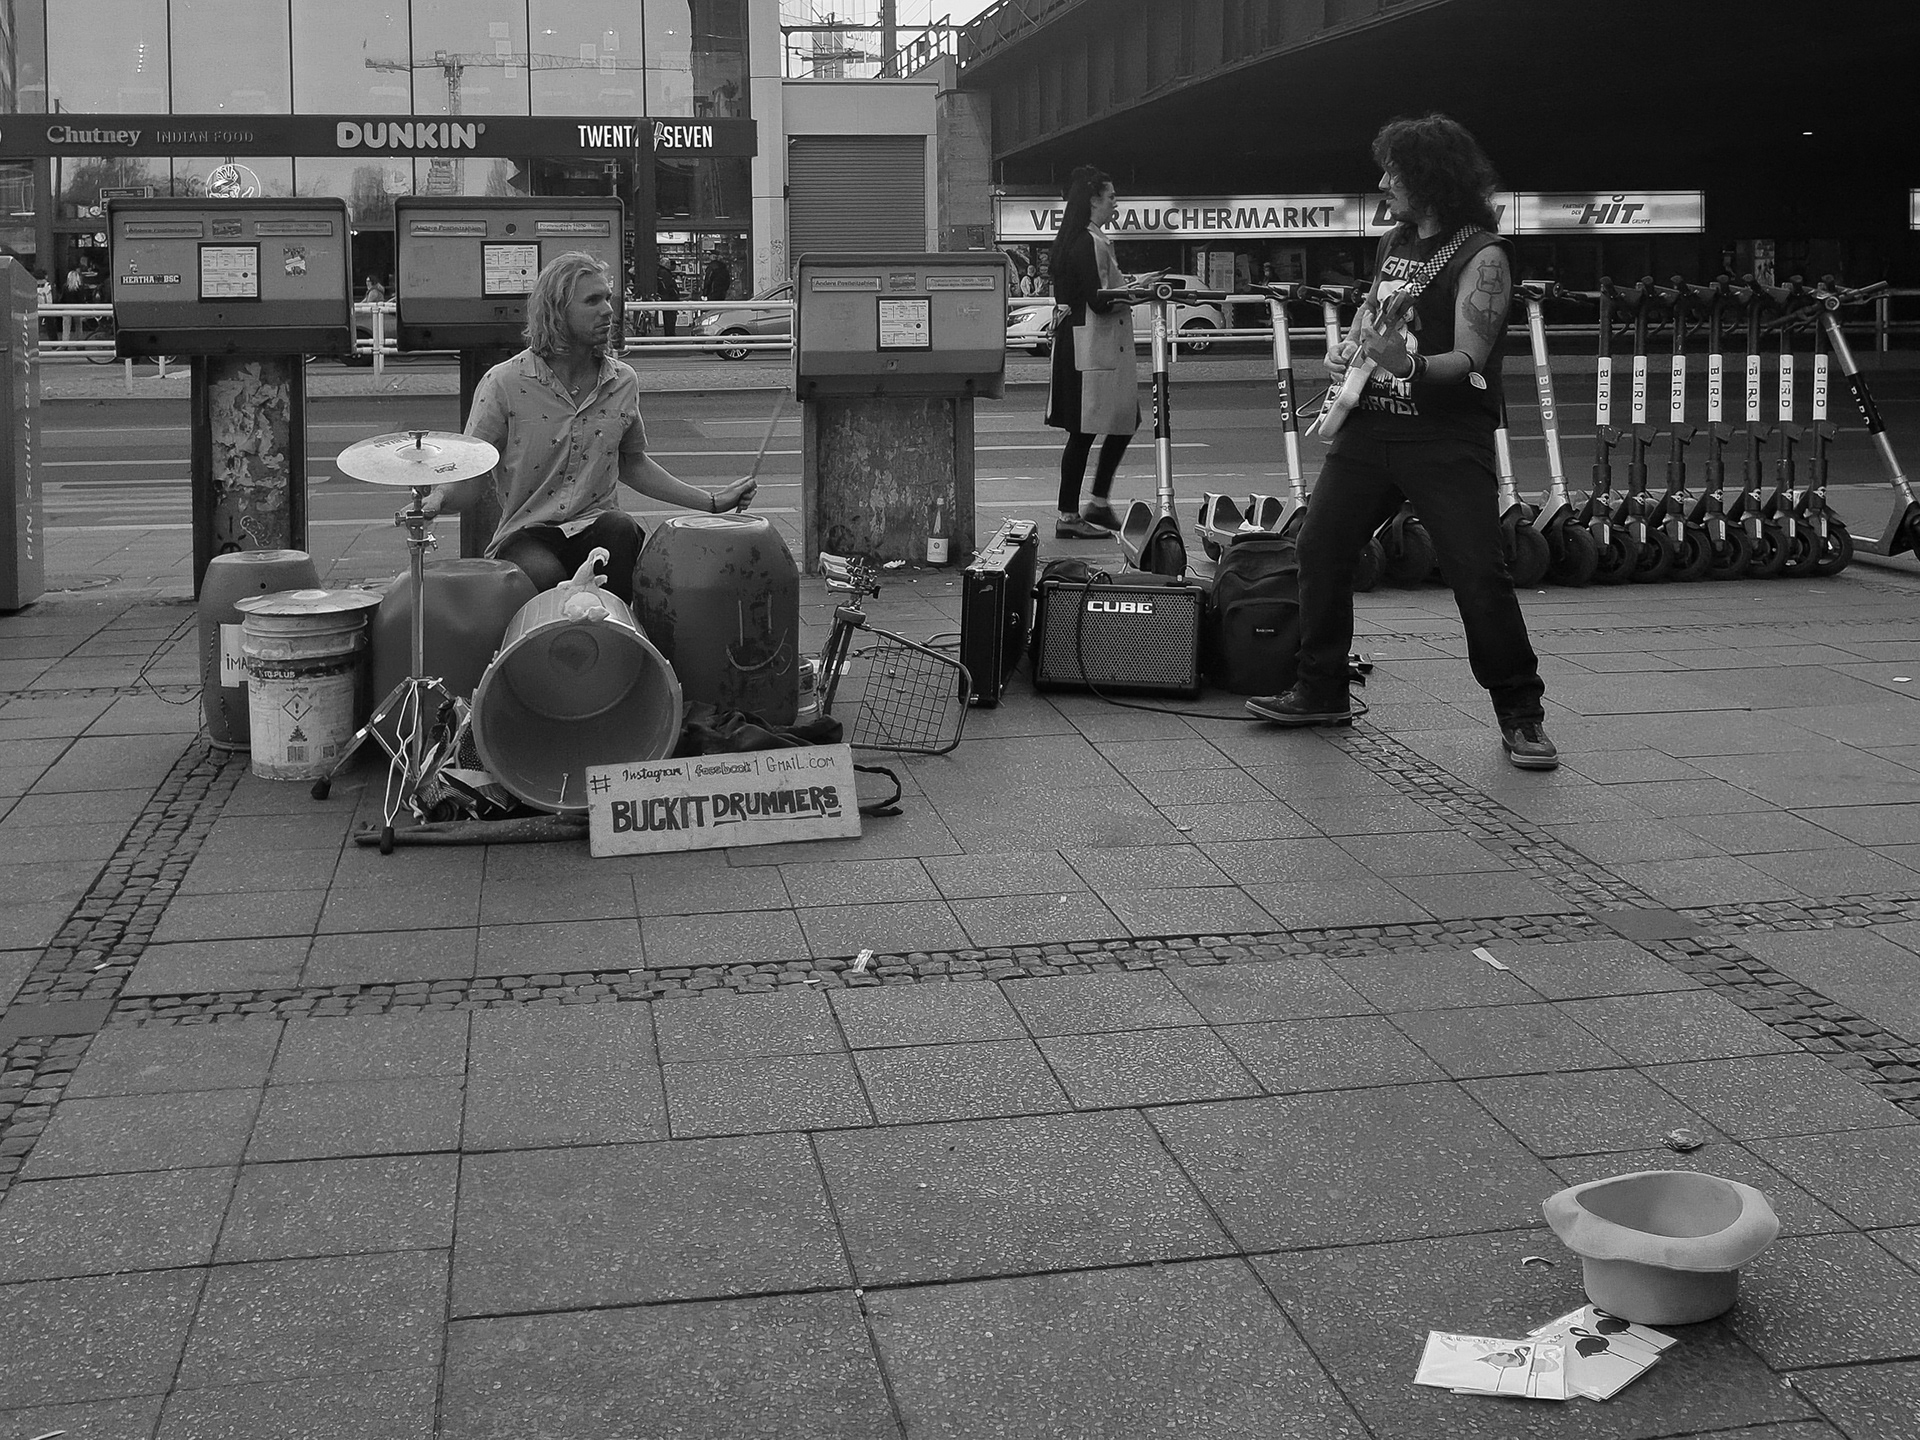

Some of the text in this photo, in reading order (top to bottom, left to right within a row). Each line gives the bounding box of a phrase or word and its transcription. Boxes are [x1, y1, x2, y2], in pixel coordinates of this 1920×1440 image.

[45, 125, 142, 147] Chutney
[155, 130, 254, 144] INDIAN FOOD
[335, 121, 486, 150] DUNKIN'
[577, 125, 639, 148] TWENT
[122, 274, 180, 284] HERTHA BSC
[1277, 379, 1290, 421] BIRD
[1538, 374, 1554, 420] BIRD
[1598, 369, 1609, 411] BIRD
[1633, 368, 1644, 411] BIRD
[1671, 368, 1683, 410] BIRD
[1709, 366, 1720, 408] BIRD
[1747, 366, 1758, 408] BIRD
[1815, 366, 1827, 408] BIRD
[1087, 600, 1153, 614] CUBE
[610, 795, 710, 834] BUCKIT
